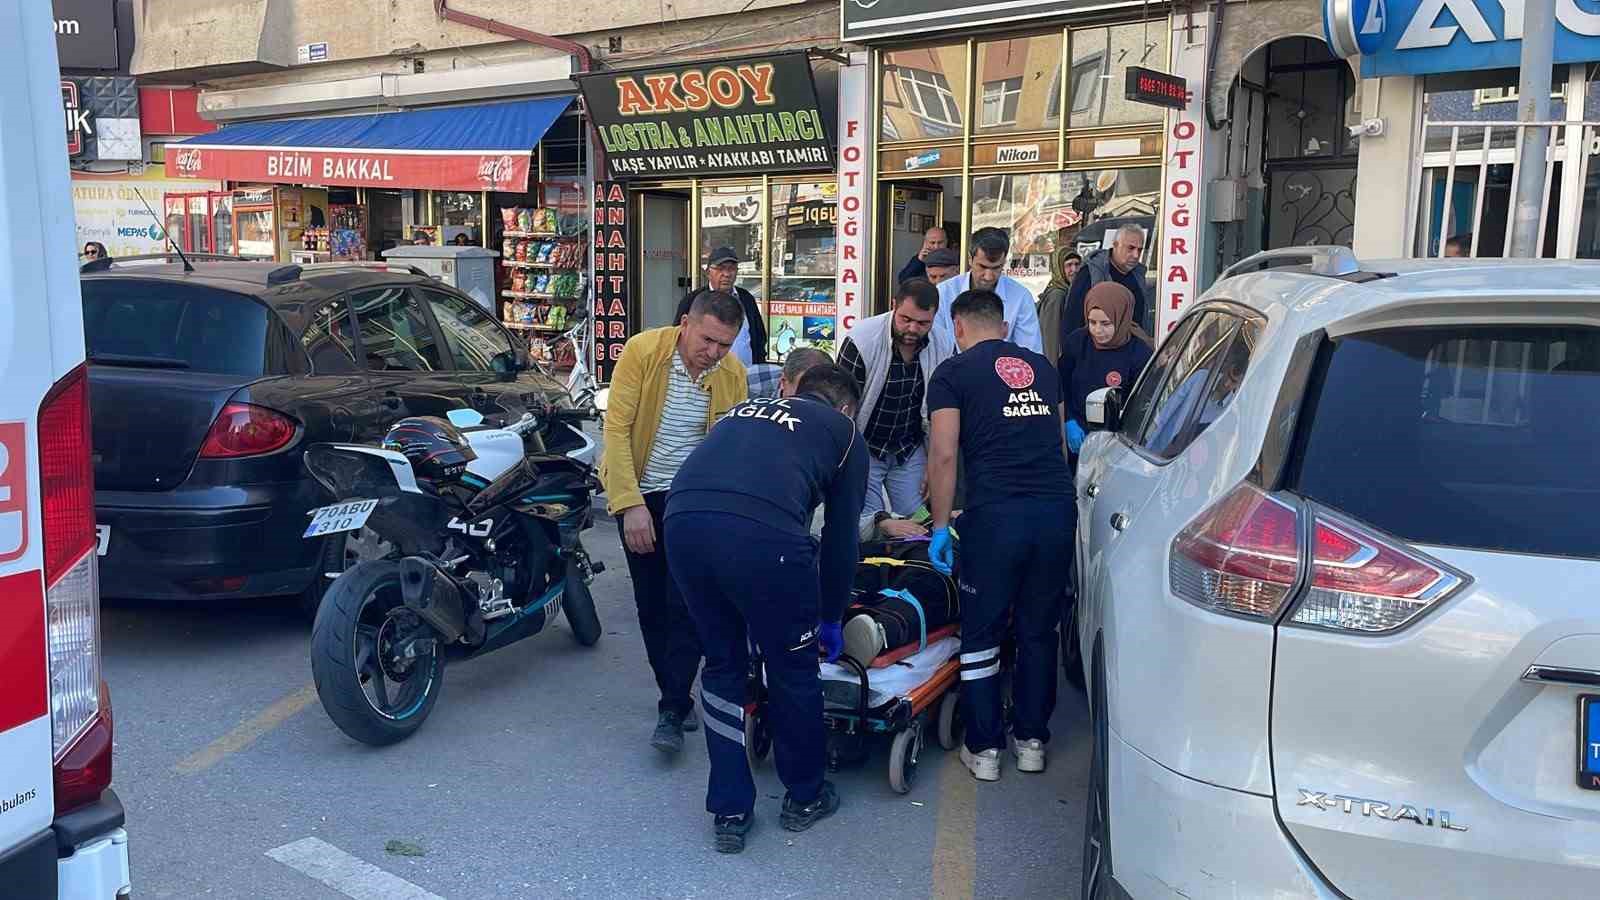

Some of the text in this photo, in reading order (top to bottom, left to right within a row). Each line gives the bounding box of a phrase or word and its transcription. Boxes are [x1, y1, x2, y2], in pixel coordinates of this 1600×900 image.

[617, 64, 774, 115] AKSOY
[600, 109, 825, 153] LOSTRA & ANAHTARCI
[268, 152, 393, 180] BİZİM BAKKAL
[612, 146, 828, 175] KAŞE YAPILIR AYAKKABI TAMİRİ
[999, 149, 1038, 161] Nikon
[842, 121, 861, 330] FOTOĞRAFC
[608, 184, 625, 361] ANAHTARC
[1003, 403, 1051, 417] SAĞLIK
[1008, 389, 1043, 403] ACİL
[727, 404, 802, 432] AĞLIK
[320, 518, 352, 532] 310
[1296, 788, 1469, 832] X-TRAIL
